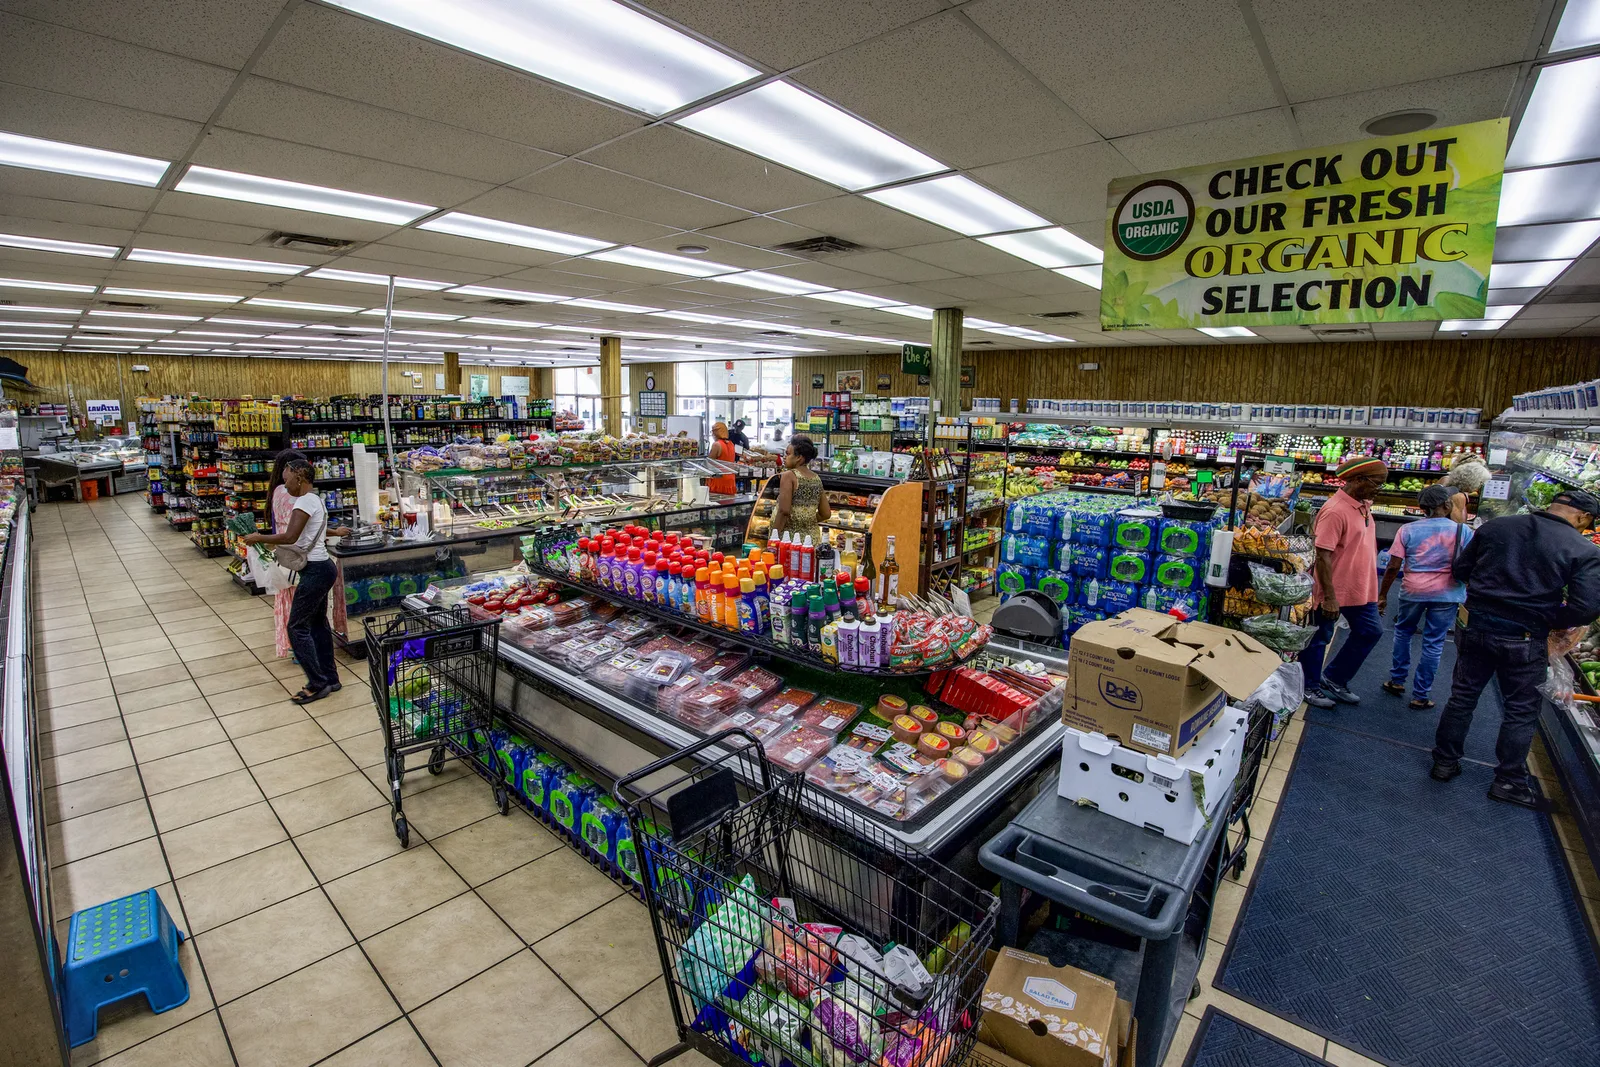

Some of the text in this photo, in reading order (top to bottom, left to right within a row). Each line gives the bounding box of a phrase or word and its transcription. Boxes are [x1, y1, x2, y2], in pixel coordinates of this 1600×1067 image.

[1208, 138, 1457, 200] CHECK OUT
[1131, 199, 1175, 219] USDA
[1205, 182, 1449, 237] OUR FRESH
[1125, 221, 1179, 239] ORGANIC
[1184, 223, 1468, 278] ORGANIC
[1202, 274, 1432, 315] SELECTION
[905, 346, 920, 363] the
[1102, 665, 1114, 673] BAGS
[1103, 657, 1115, 665] BAGS
[1149, 669, 1164, 678] COUNT
[1165, 673, 1180, 682] LOOSE
[1105, 680, 1138, 703] Dole
[1028, 988, 1070, 1007] SALAD FARM
